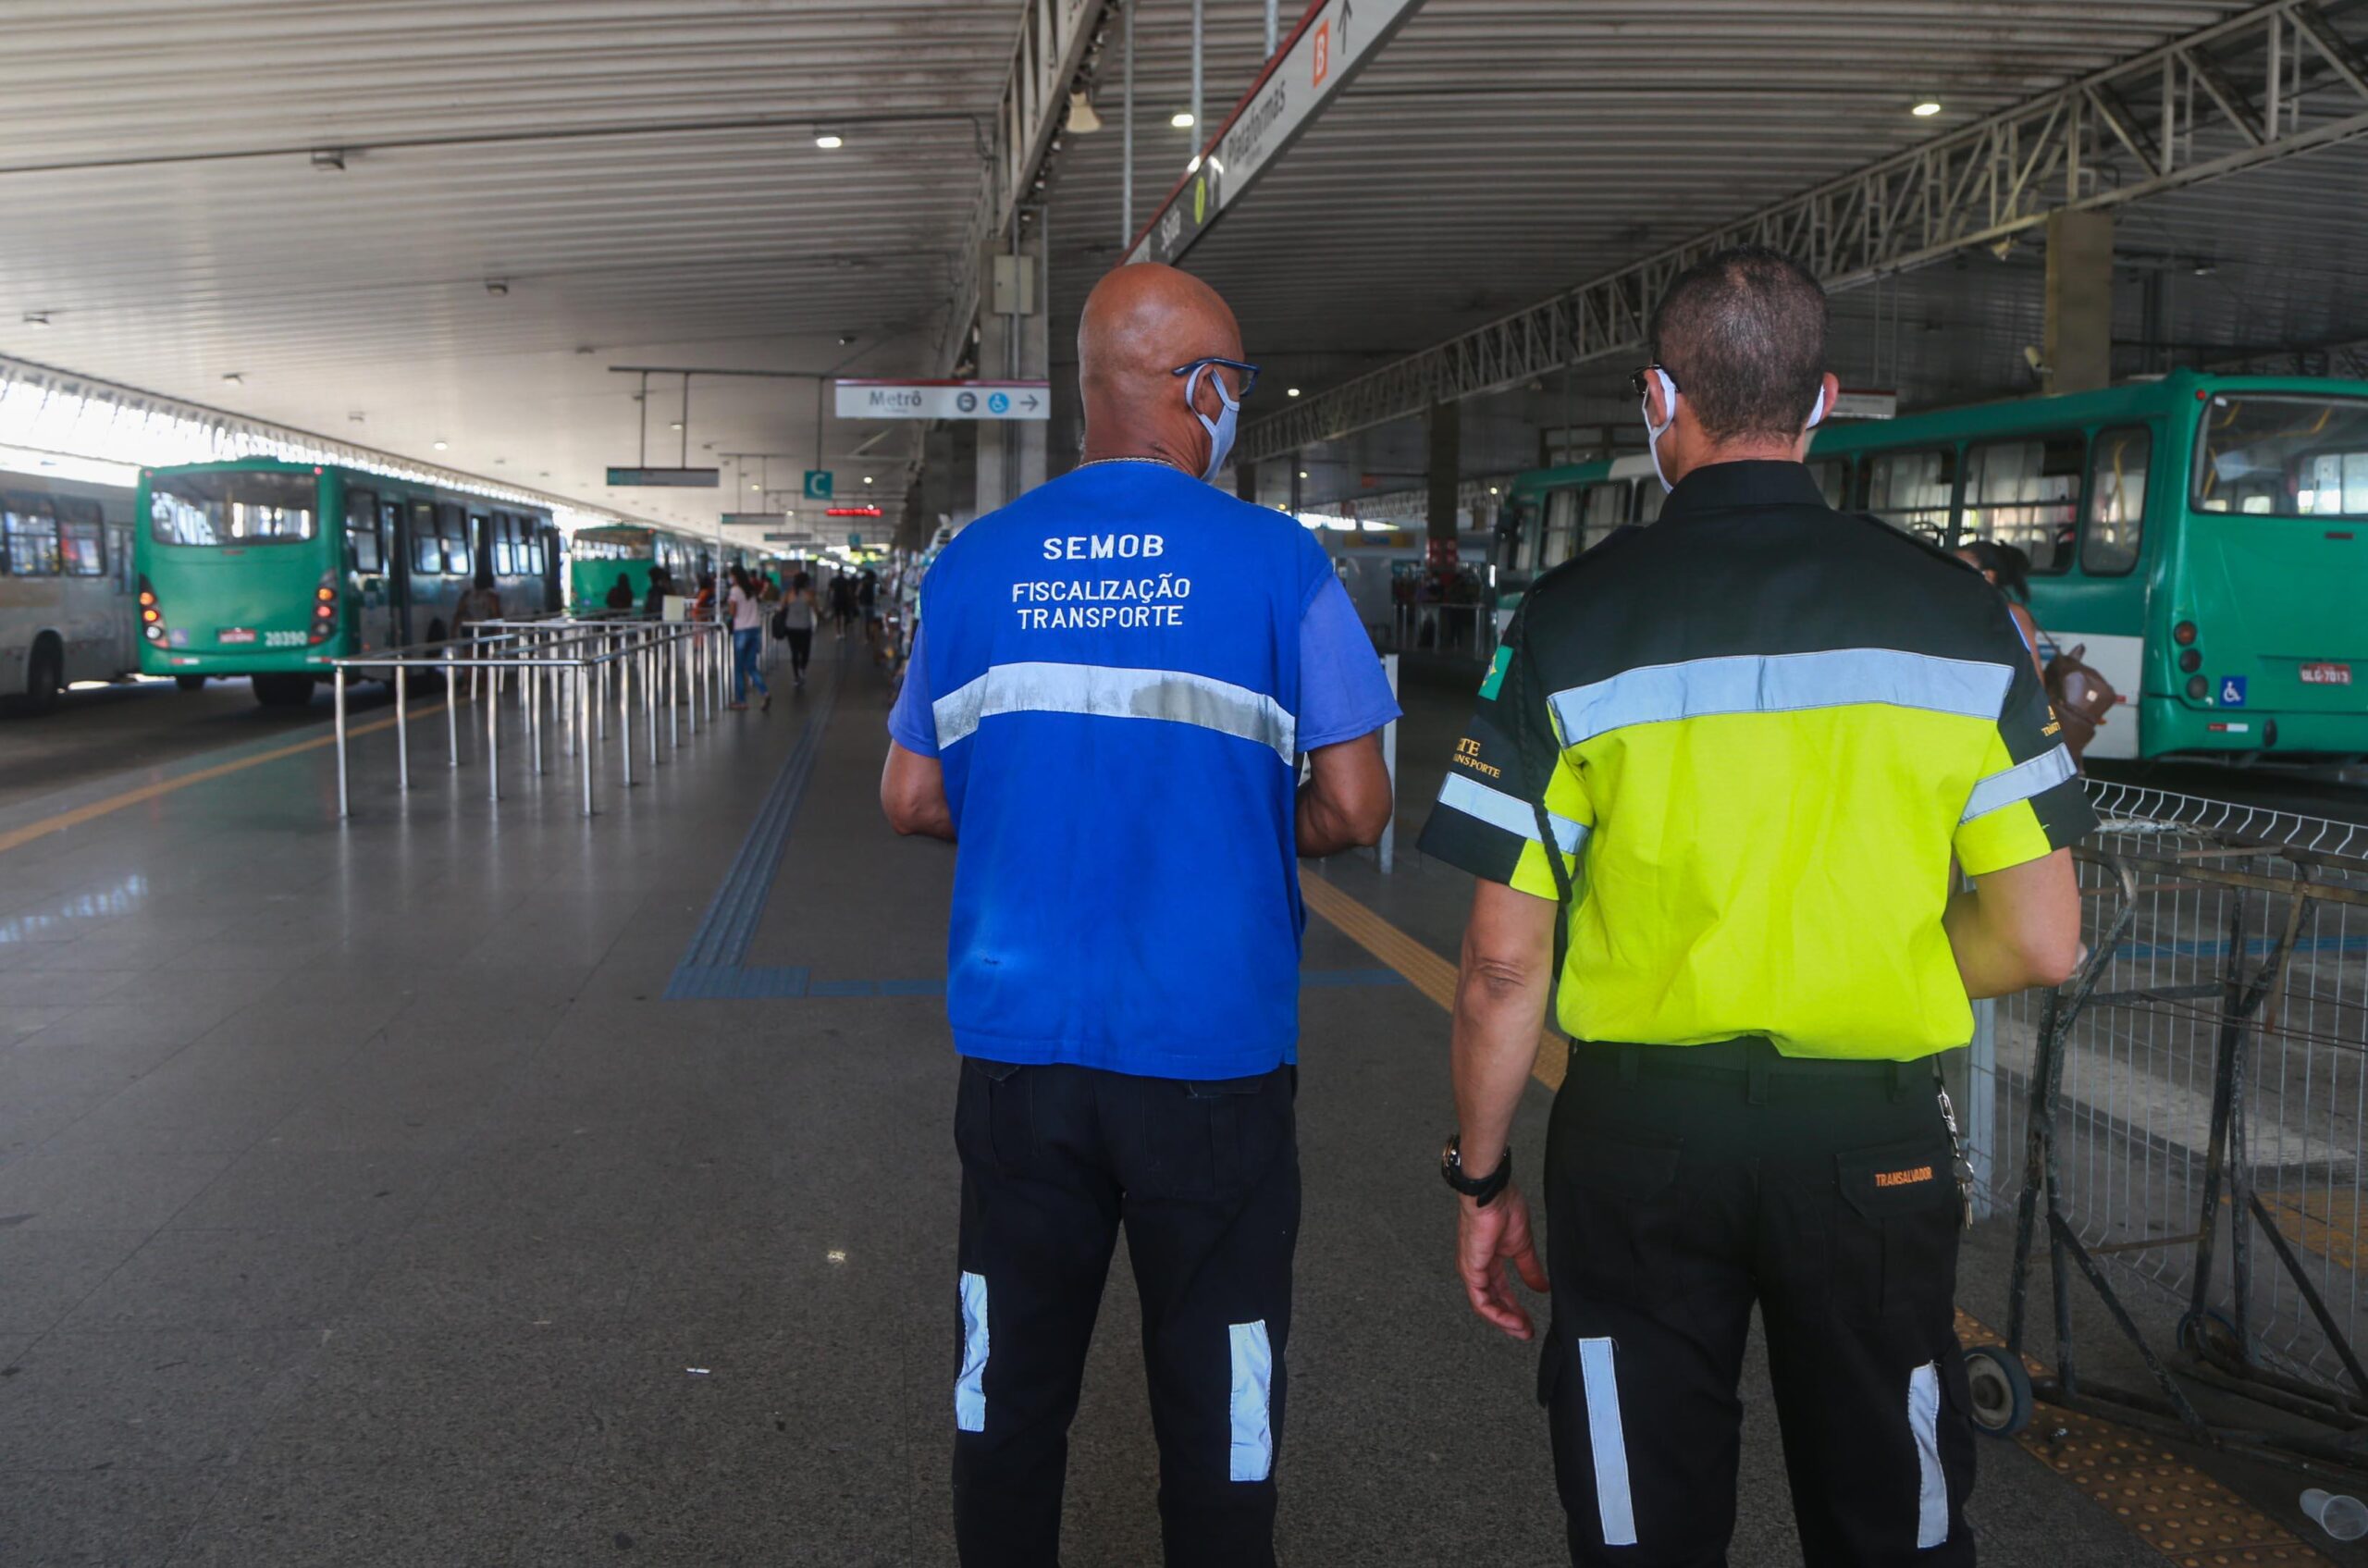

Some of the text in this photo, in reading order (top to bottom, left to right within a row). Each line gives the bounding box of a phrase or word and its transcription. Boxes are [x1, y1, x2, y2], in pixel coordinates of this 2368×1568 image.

[869, 389, 922, 408] Metrô
[810, 474, 827, 496] C
[1042, 534, 1165, 561] SEMOB
[1012, 573, 1191, 604] FISCALIZAÇÃO
[1017, 605, 1184, 630] TRANSPORTE
[1874, 1166, 1933, 1188] TRANSALVADOR
